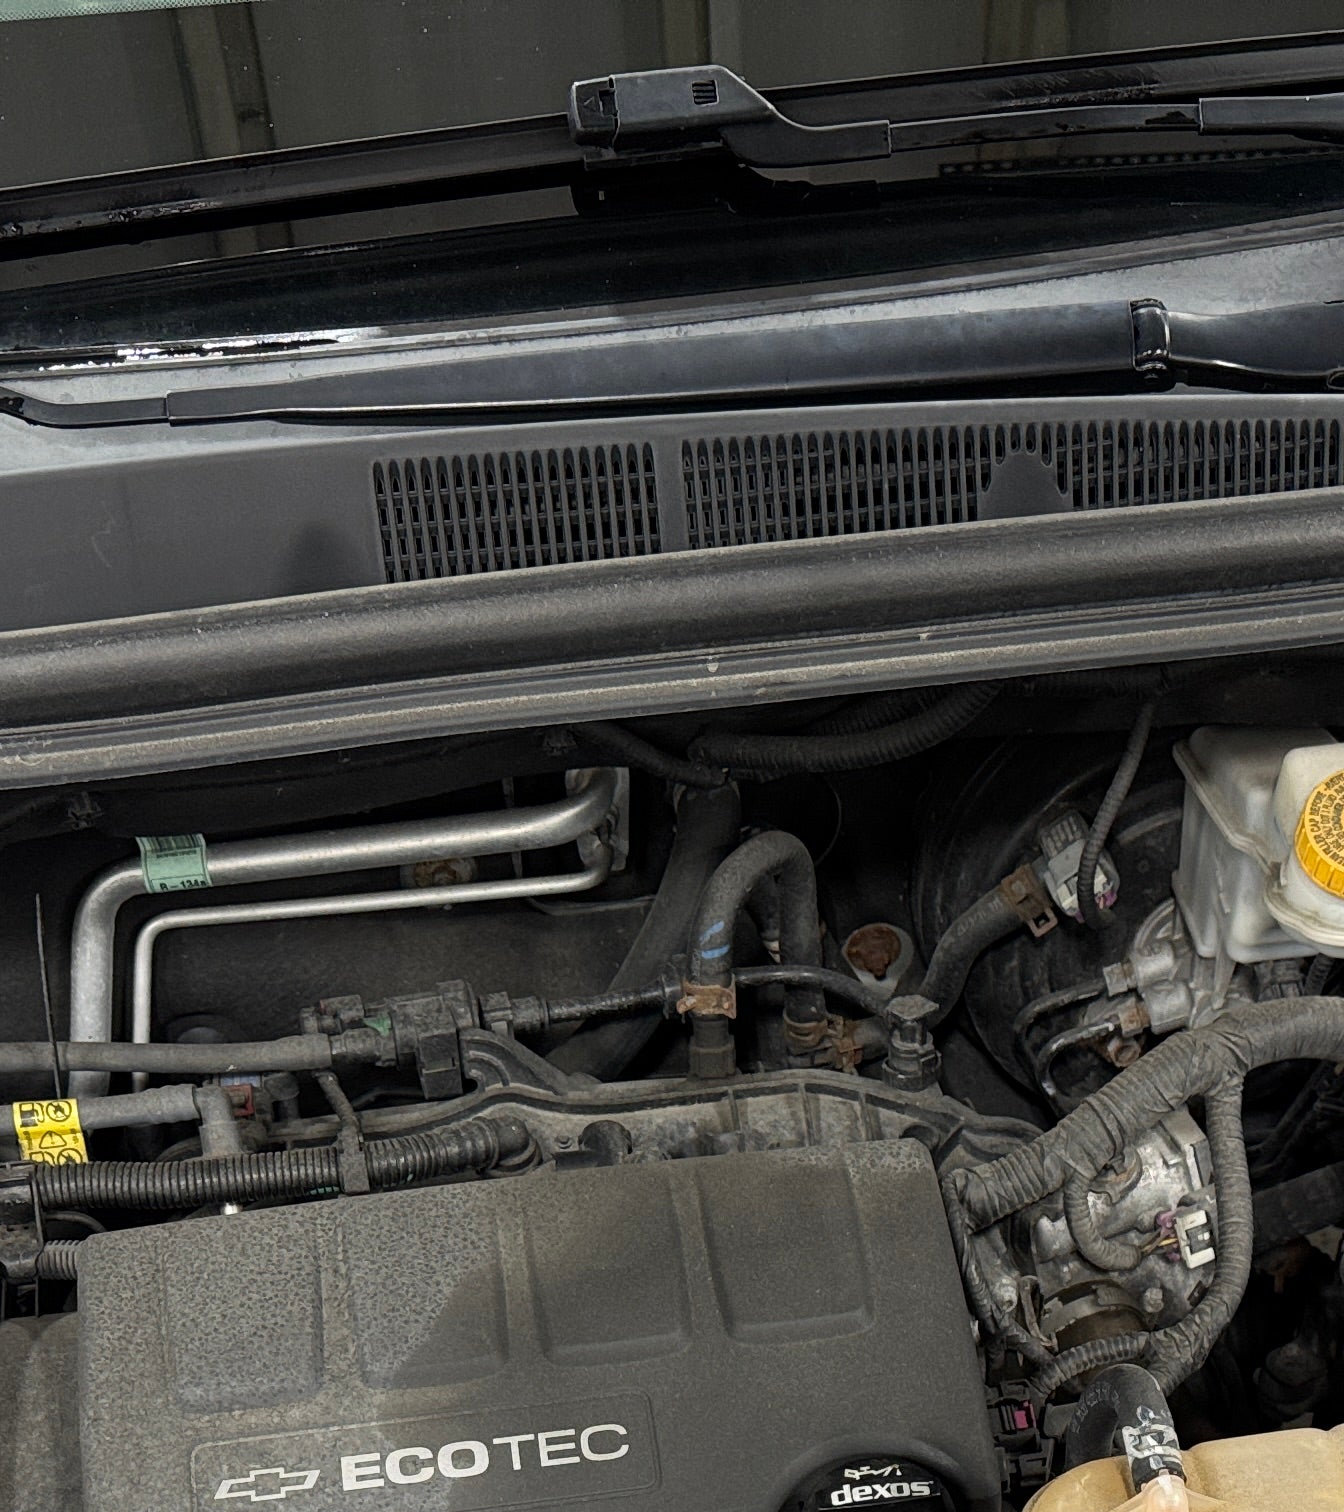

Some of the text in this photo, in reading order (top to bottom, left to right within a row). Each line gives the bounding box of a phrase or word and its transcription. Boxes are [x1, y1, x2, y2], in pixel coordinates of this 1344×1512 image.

[1309, 818, 1321, 833] CAP
[341, 1423, 630, 1491] ECOTEC
[830, 1481, 931, 1506] dexos
